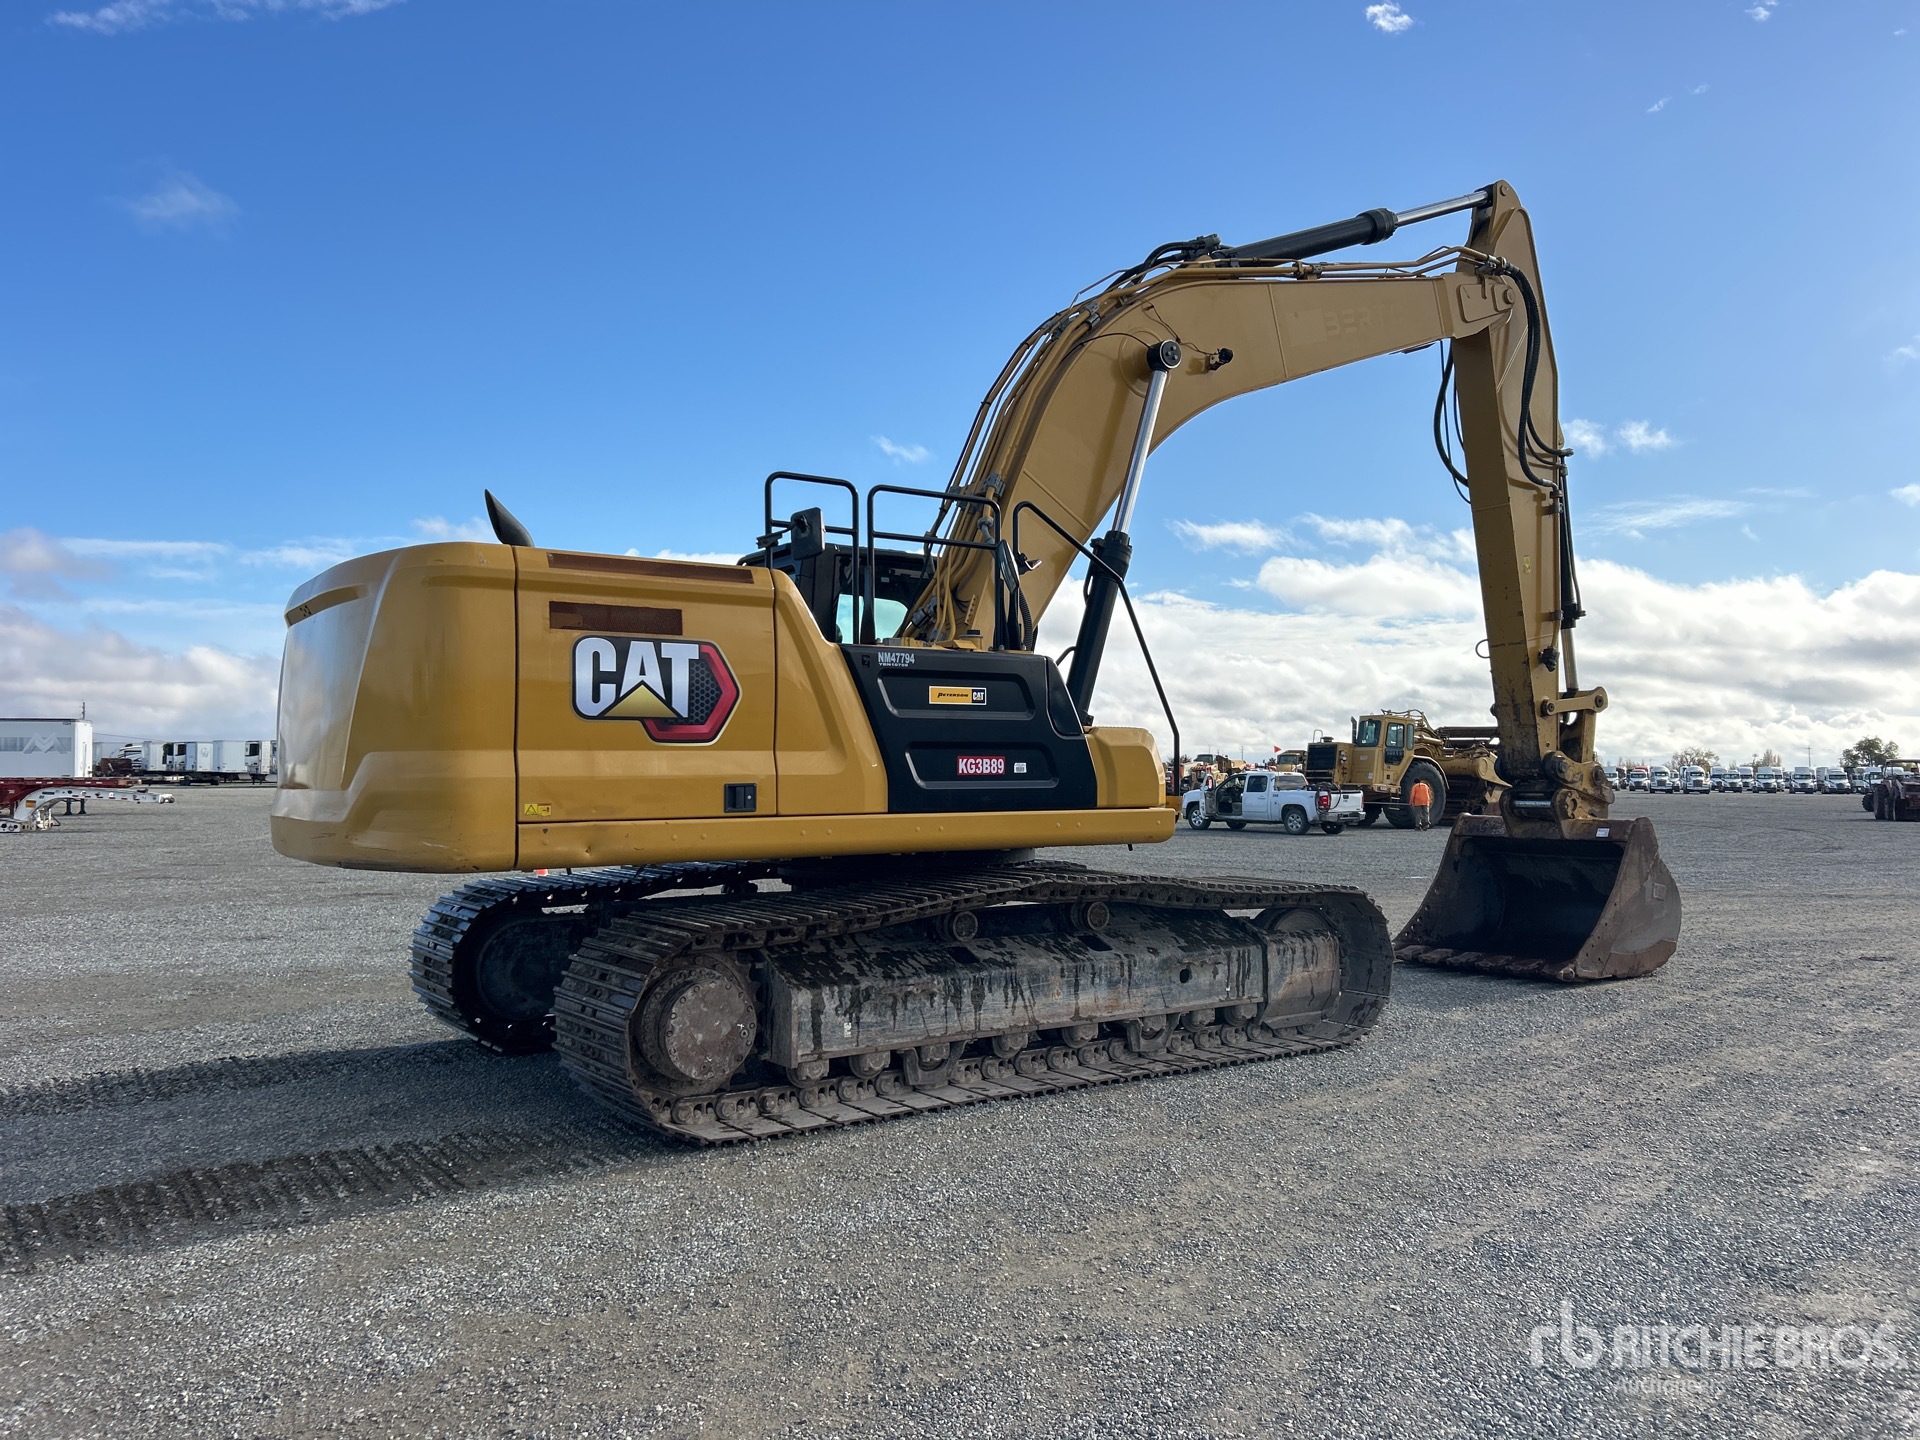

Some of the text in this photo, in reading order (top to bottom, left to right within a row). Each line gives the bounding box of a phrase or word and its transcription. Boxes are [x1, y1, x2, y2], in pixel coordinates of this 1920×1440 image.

[878, 651, 915, 664] NM47794
[575, 637, 699, 718] CAT
[972, 691, 984, 701] CAT
[958, 758, 1004, 774] KG3B89
